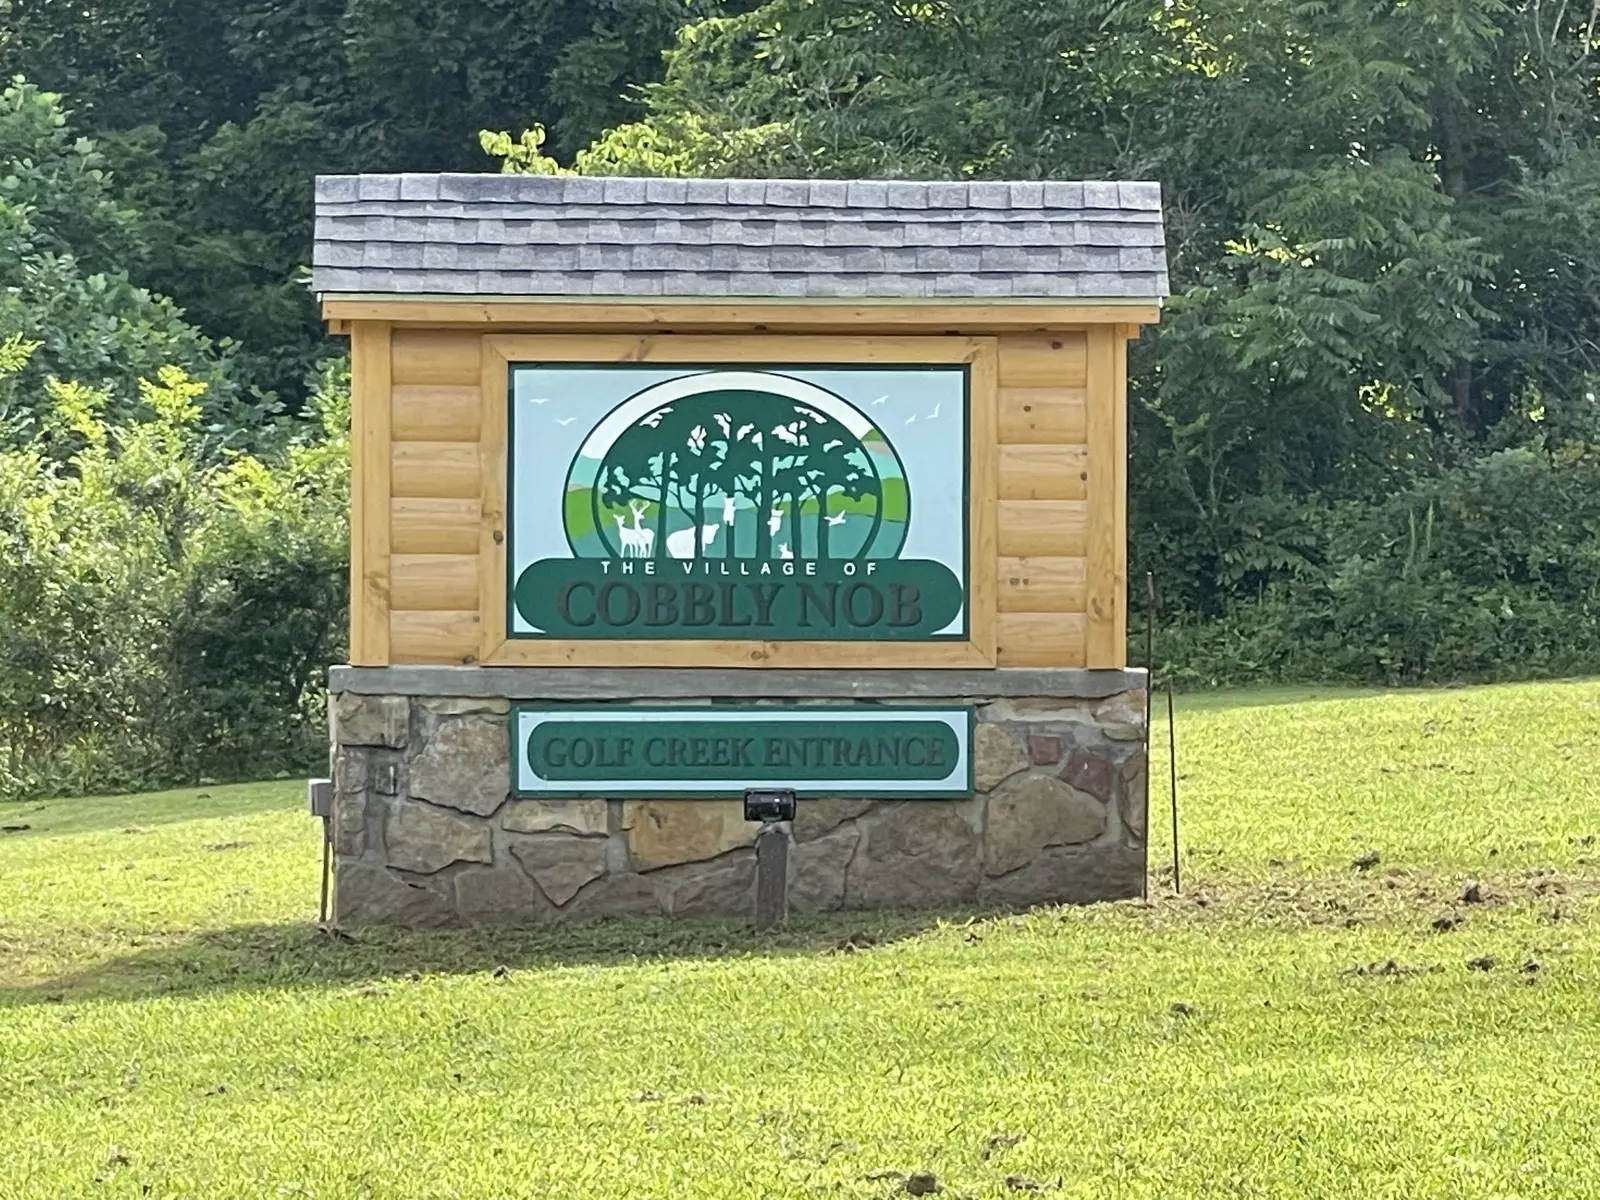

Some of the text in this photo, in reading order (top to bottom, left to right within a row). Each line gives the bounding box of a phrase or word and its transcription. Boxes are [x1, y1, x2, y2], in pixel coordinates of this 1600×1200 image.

[601, 561, 878, 576] THE VILLAGE OF
[556, 581, 923, 628] COBBLY NOB
[542, 736, 947, 768] GOLF CREEK ENTRANCE
